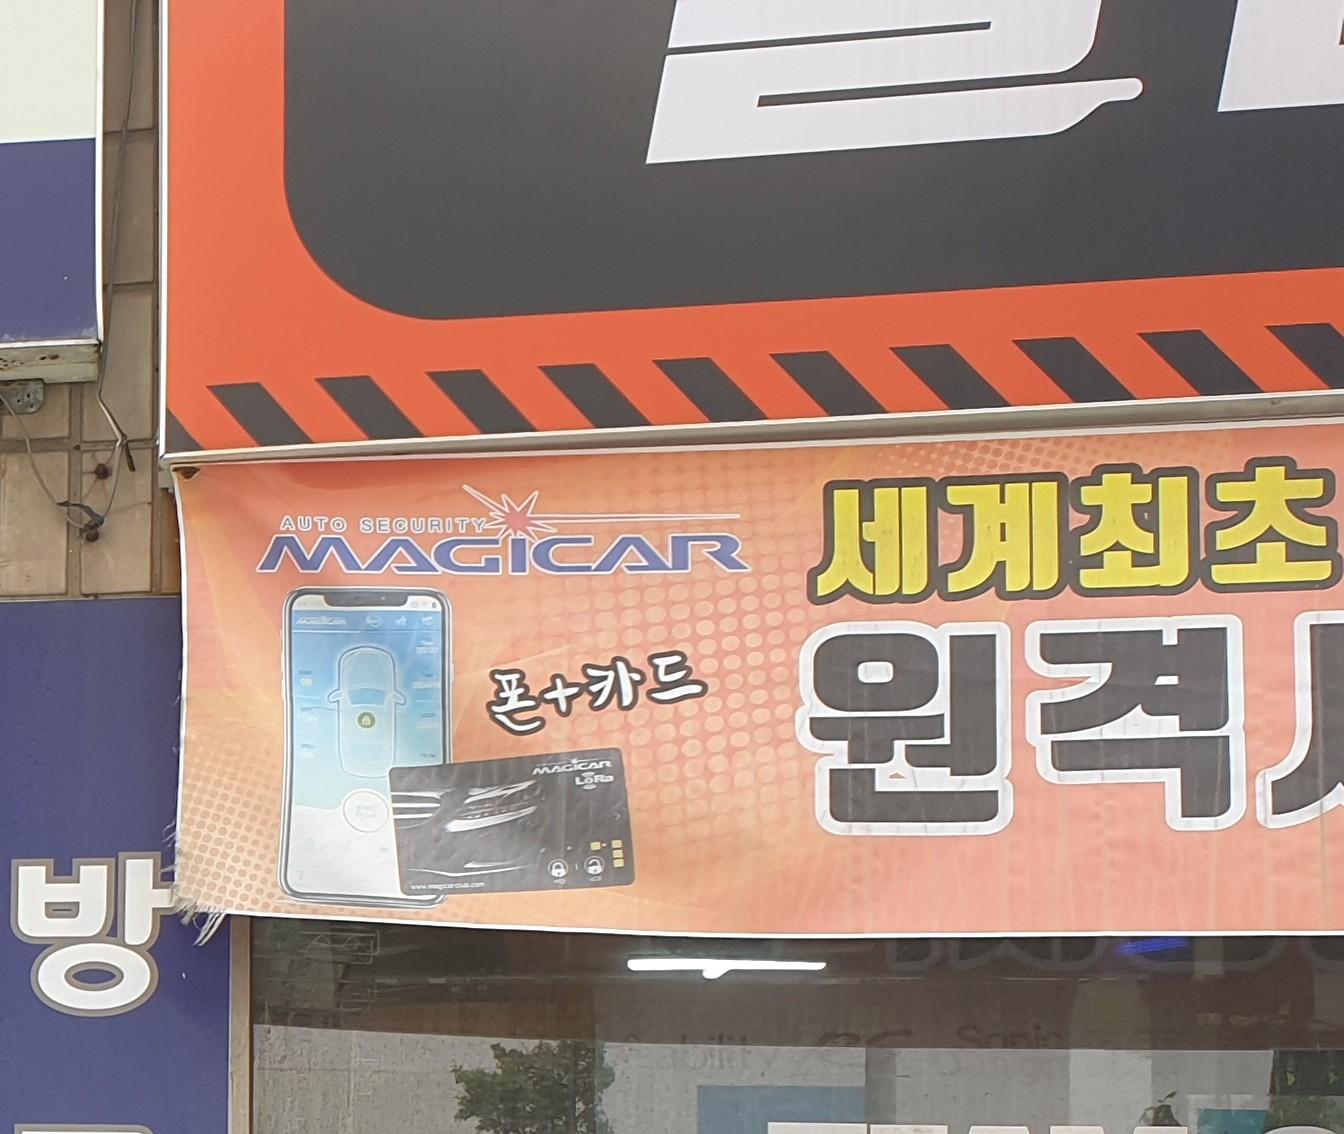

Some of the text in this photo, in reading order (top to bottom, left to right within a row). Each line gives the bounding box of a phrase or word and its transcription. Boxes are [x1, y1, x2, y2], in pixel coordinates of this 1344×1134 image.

[280, 515, 488, 535] AUTO SECURITY
[807, 457, 1342, 604] 세계최초
[256, 533, 751, 576] MAGICAR
[486, 650, 709, 737] 폰+카드
[532, 759, 613, 777] MAGICAR
